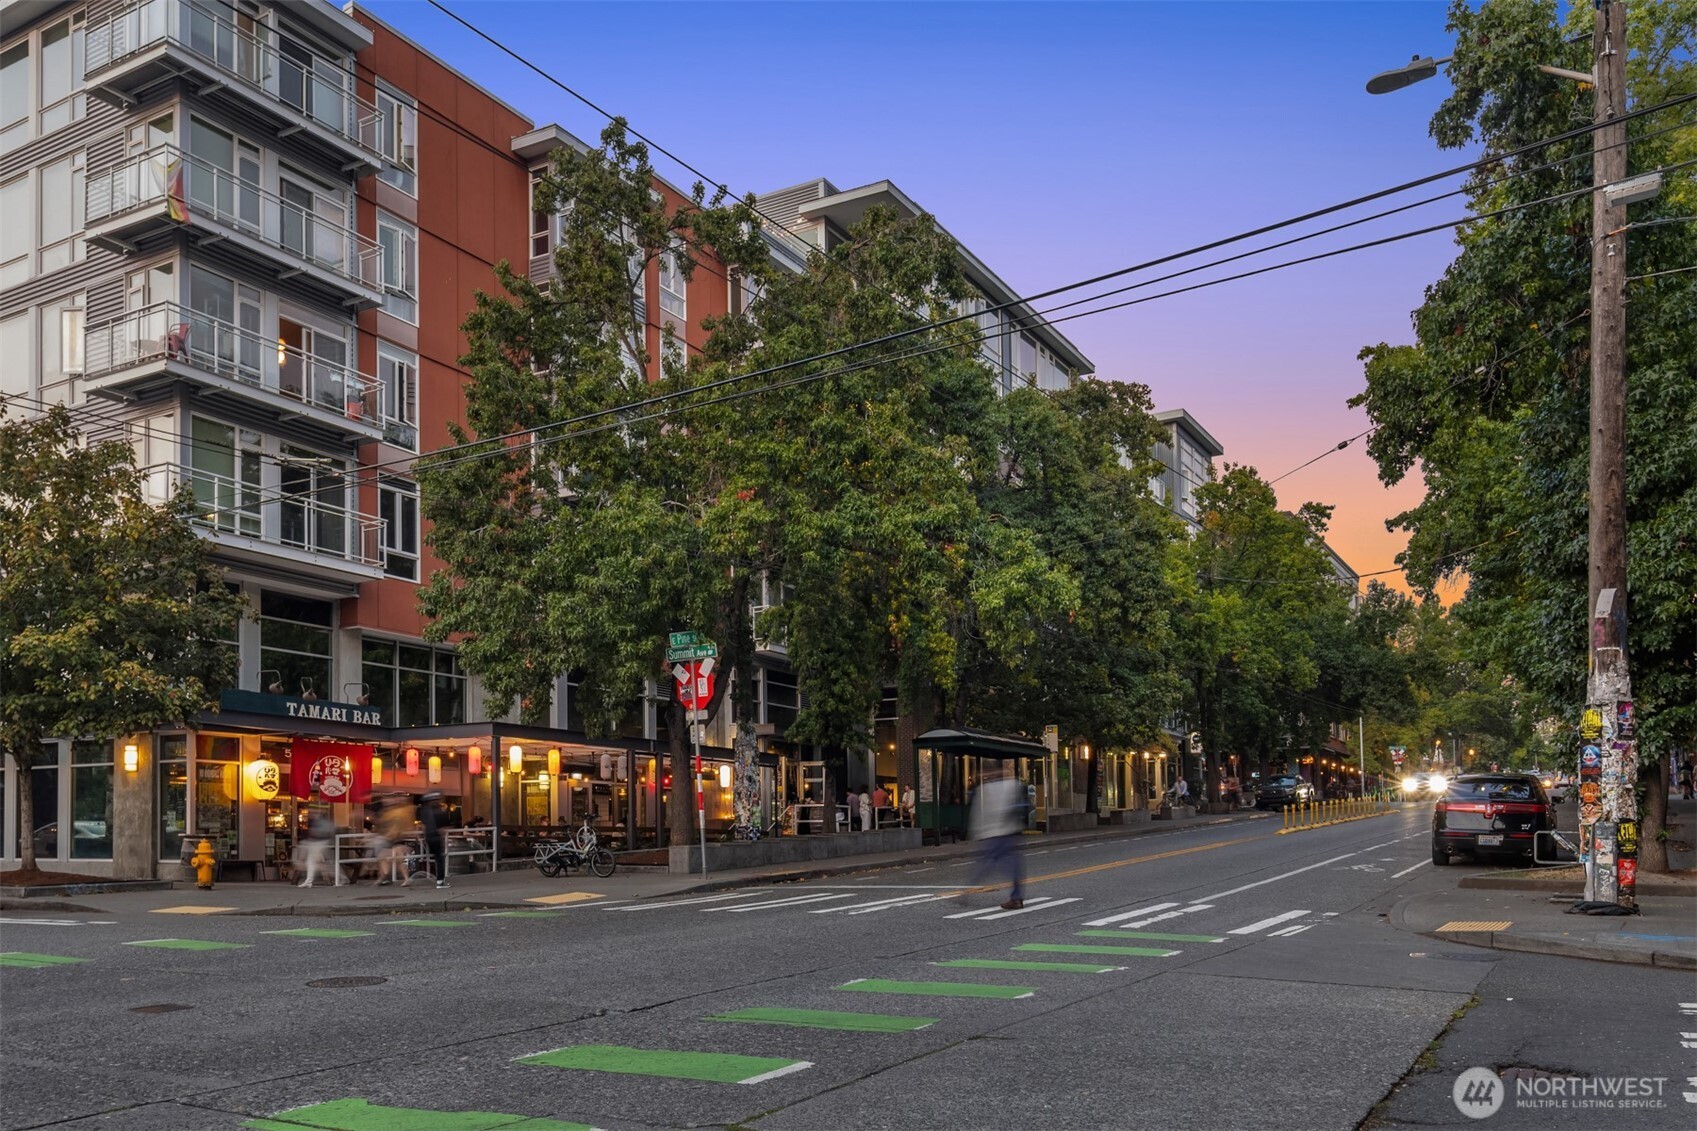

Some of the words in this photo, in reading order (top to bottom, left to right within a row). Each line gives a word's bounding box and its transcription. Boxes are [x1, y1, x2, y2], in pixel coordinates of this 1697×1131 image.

[672, 637, 676, 645] E
[676, 633, 691, 645] Pine
[668, 647, 695, 660] Summit
[696, 649, 707, 657] Ave
[286, 702, 348, 722] TAMARI
[352, 709, 382, 726] BAR
